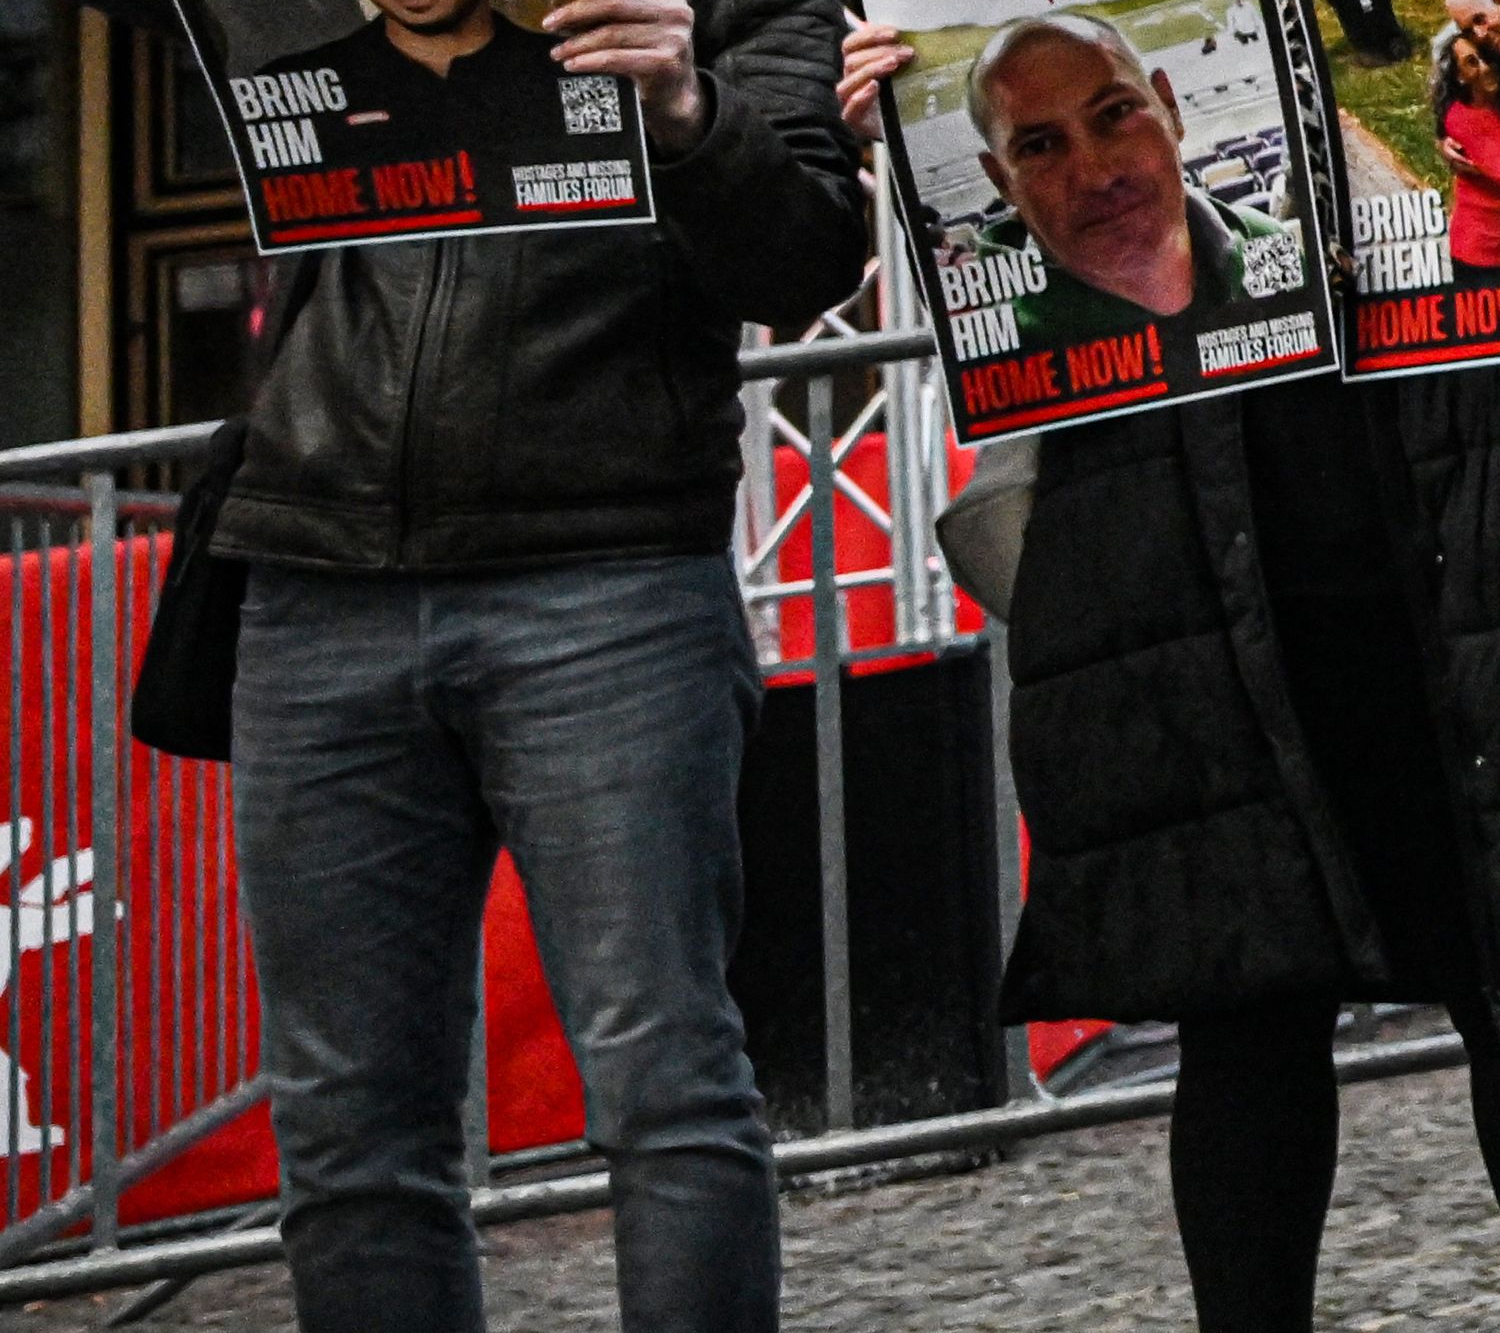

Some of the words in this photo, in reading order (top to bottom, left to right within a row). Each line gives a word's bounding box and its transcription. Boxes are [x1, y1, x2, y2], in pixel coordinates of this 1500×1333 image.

[229, 67, 349, 121] BRING
[246, 117, 322, 170] HIM
[262, 168, 366, 222] HOME
[371, 150, 477, 211] NOW!
[516, 179, 581, 206] FAMILIES
[582, 177, 635, 202] FORUM
[1352, 189, 1447, 243] BRING
[939, 245, 1048, 312] BRING
[1355, 241, 1448, 294] THEM
[950, 302, 1020, 362] HIM
[1358, 295, 1447, 348] HOME
[962, 350, 1060, 415] HOME
[1066, 323, 1163, 393] NOW!
[1200, 337, 1265, 373] FAMILIES
[1266, 327, 1318, 360] FORUM
